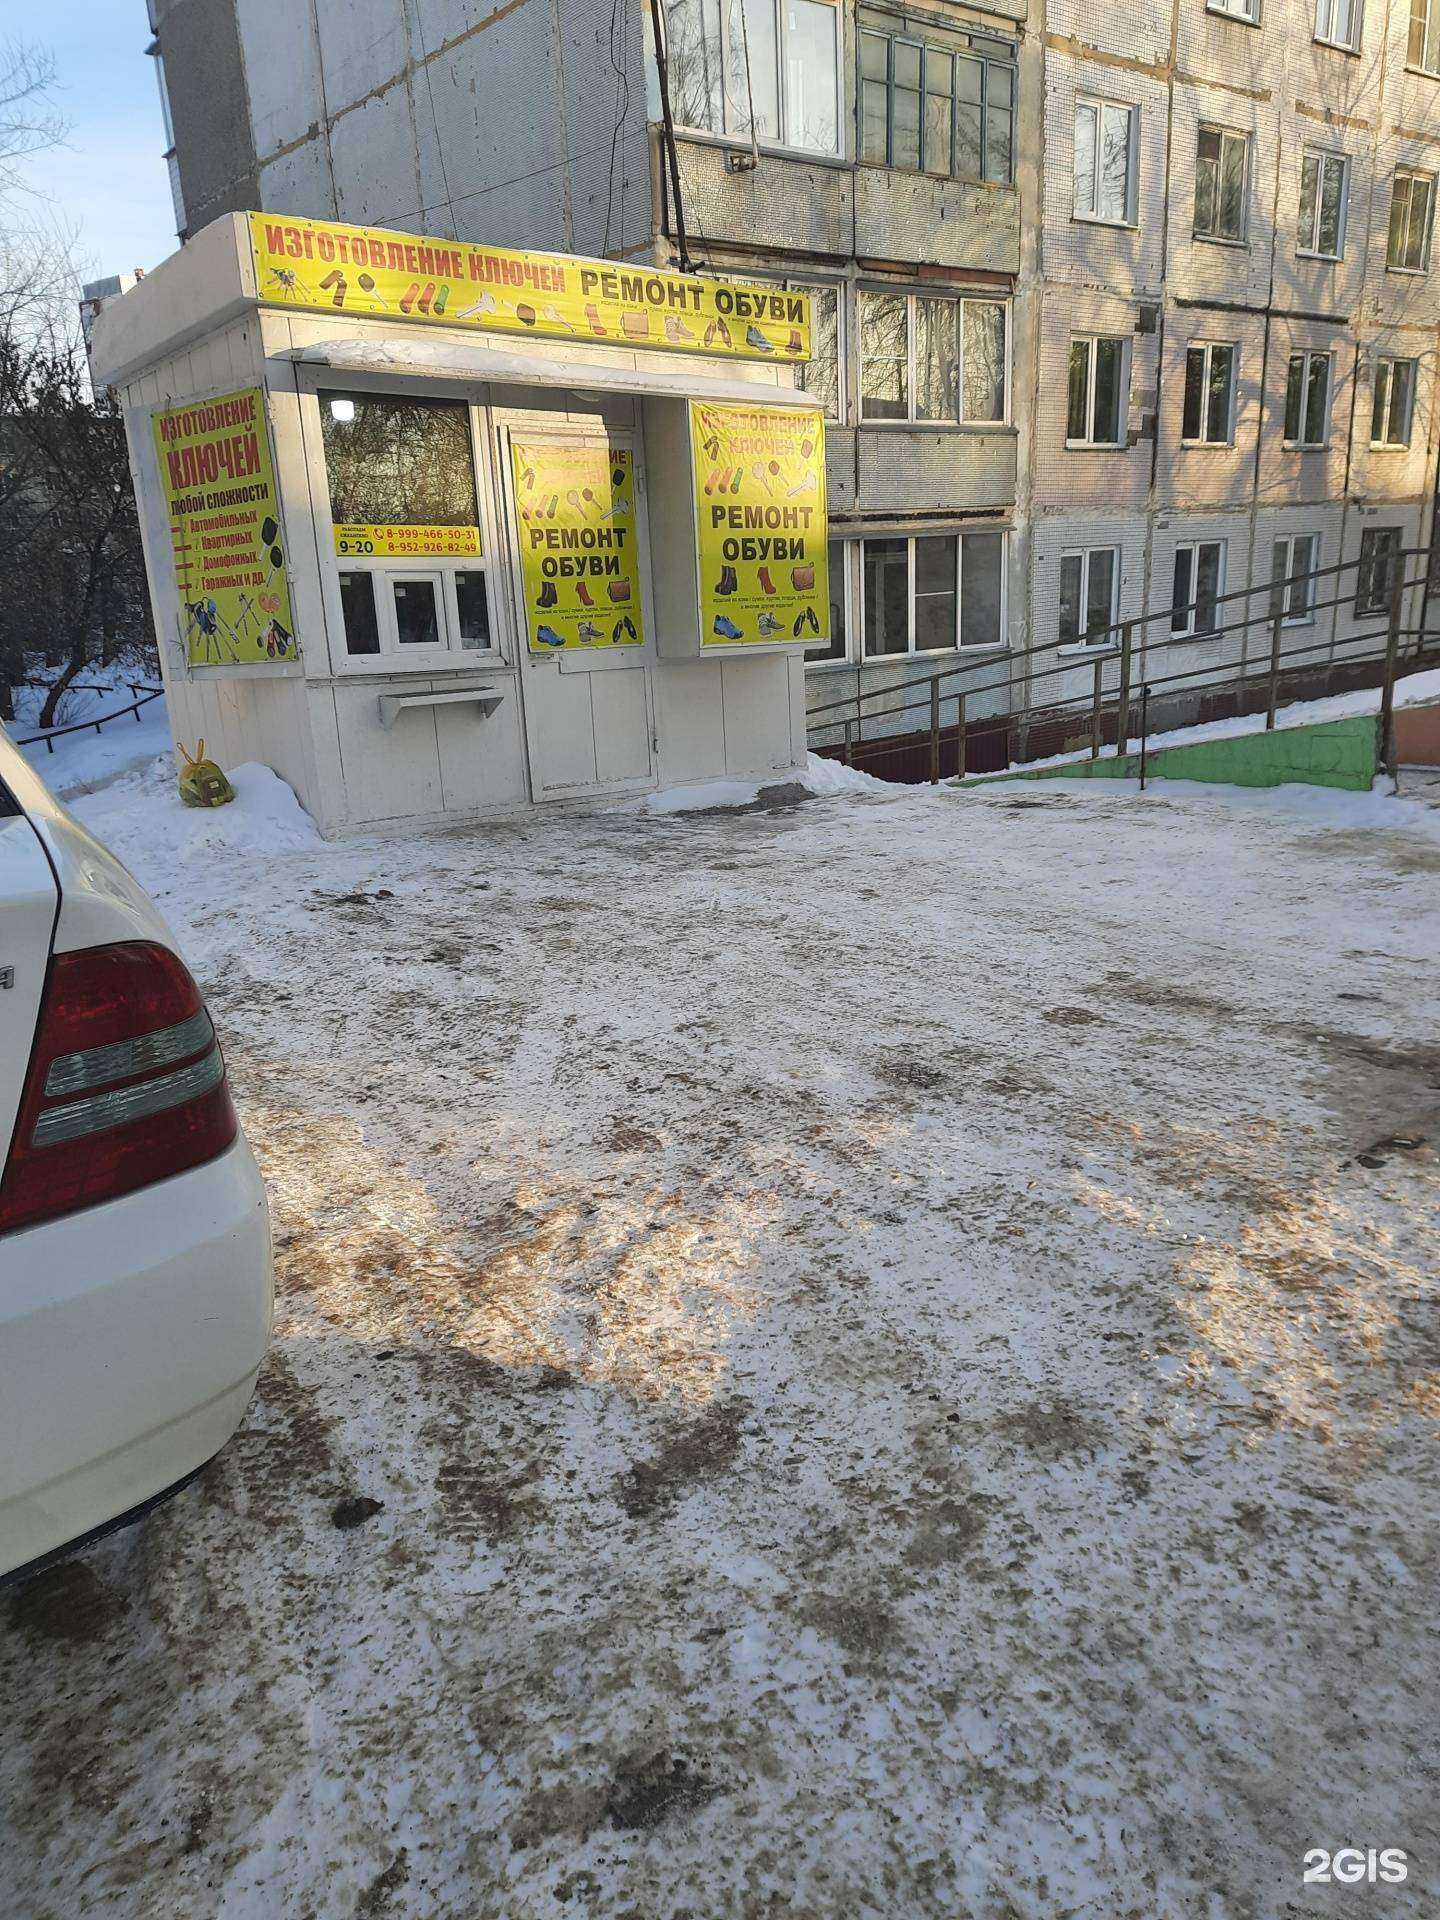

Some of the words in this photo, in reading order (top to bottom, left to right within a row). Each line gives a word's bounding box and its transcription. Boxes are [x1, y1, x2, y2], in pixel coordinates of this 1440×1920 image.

[265, 223, 464, 280] ИЗГОТОВЛЕНИЕ
[468, 253, 566, 293] КЛЮЧЕЙ
[580, 267, 704, 311] РЕМОНТ
[714, 288, 804, 324] ОБУВИ
[160, 395, 257, 442] ИЗГОТОВЛЕНИЕ
[166, 423, 261, 491] КЛЮЧЕЙ
[711, 504, 814, 529] РЕМОНТ
[386, 528, 476, 540] 8-999-466-50-31
[530, 527, 627, 549] РЕМОНТ
[339, 540, 374, 554] 9-20
[387, 541, 477, 553] 8-952-926-82-49
[722, 537, 805, 561] ОБУВИ
[541, 555, 620, 577] ОБУВИ
